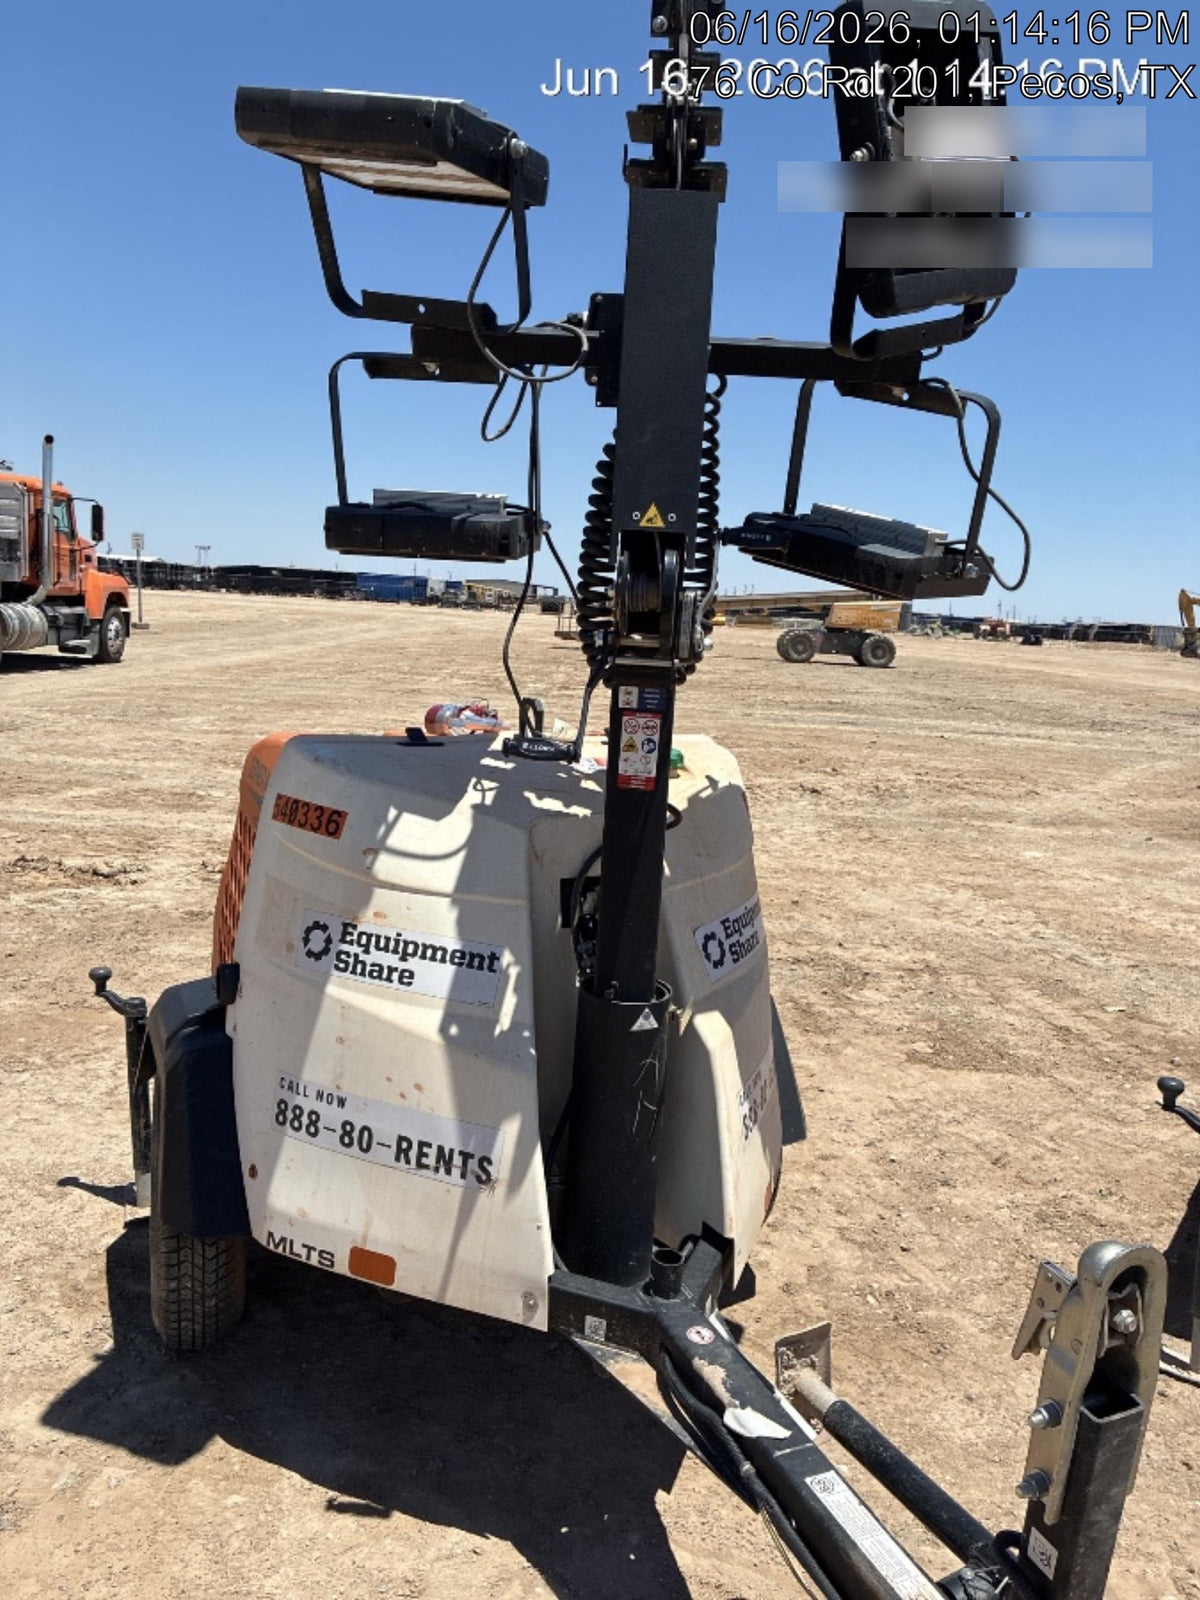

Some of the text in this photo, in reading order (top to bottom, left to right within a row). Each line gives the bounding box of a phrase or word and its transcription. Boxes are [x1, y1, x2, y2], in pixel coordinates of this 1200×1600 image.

[338, 921, 500, 973] Equipment
[333, 949, 415, 987] Share
[278, 1076, 348, 1110] CALL NOW
[274, 1098, 494, 1186] 888-80-RENTS
[265, 1230, 336, 1270] MLTS
